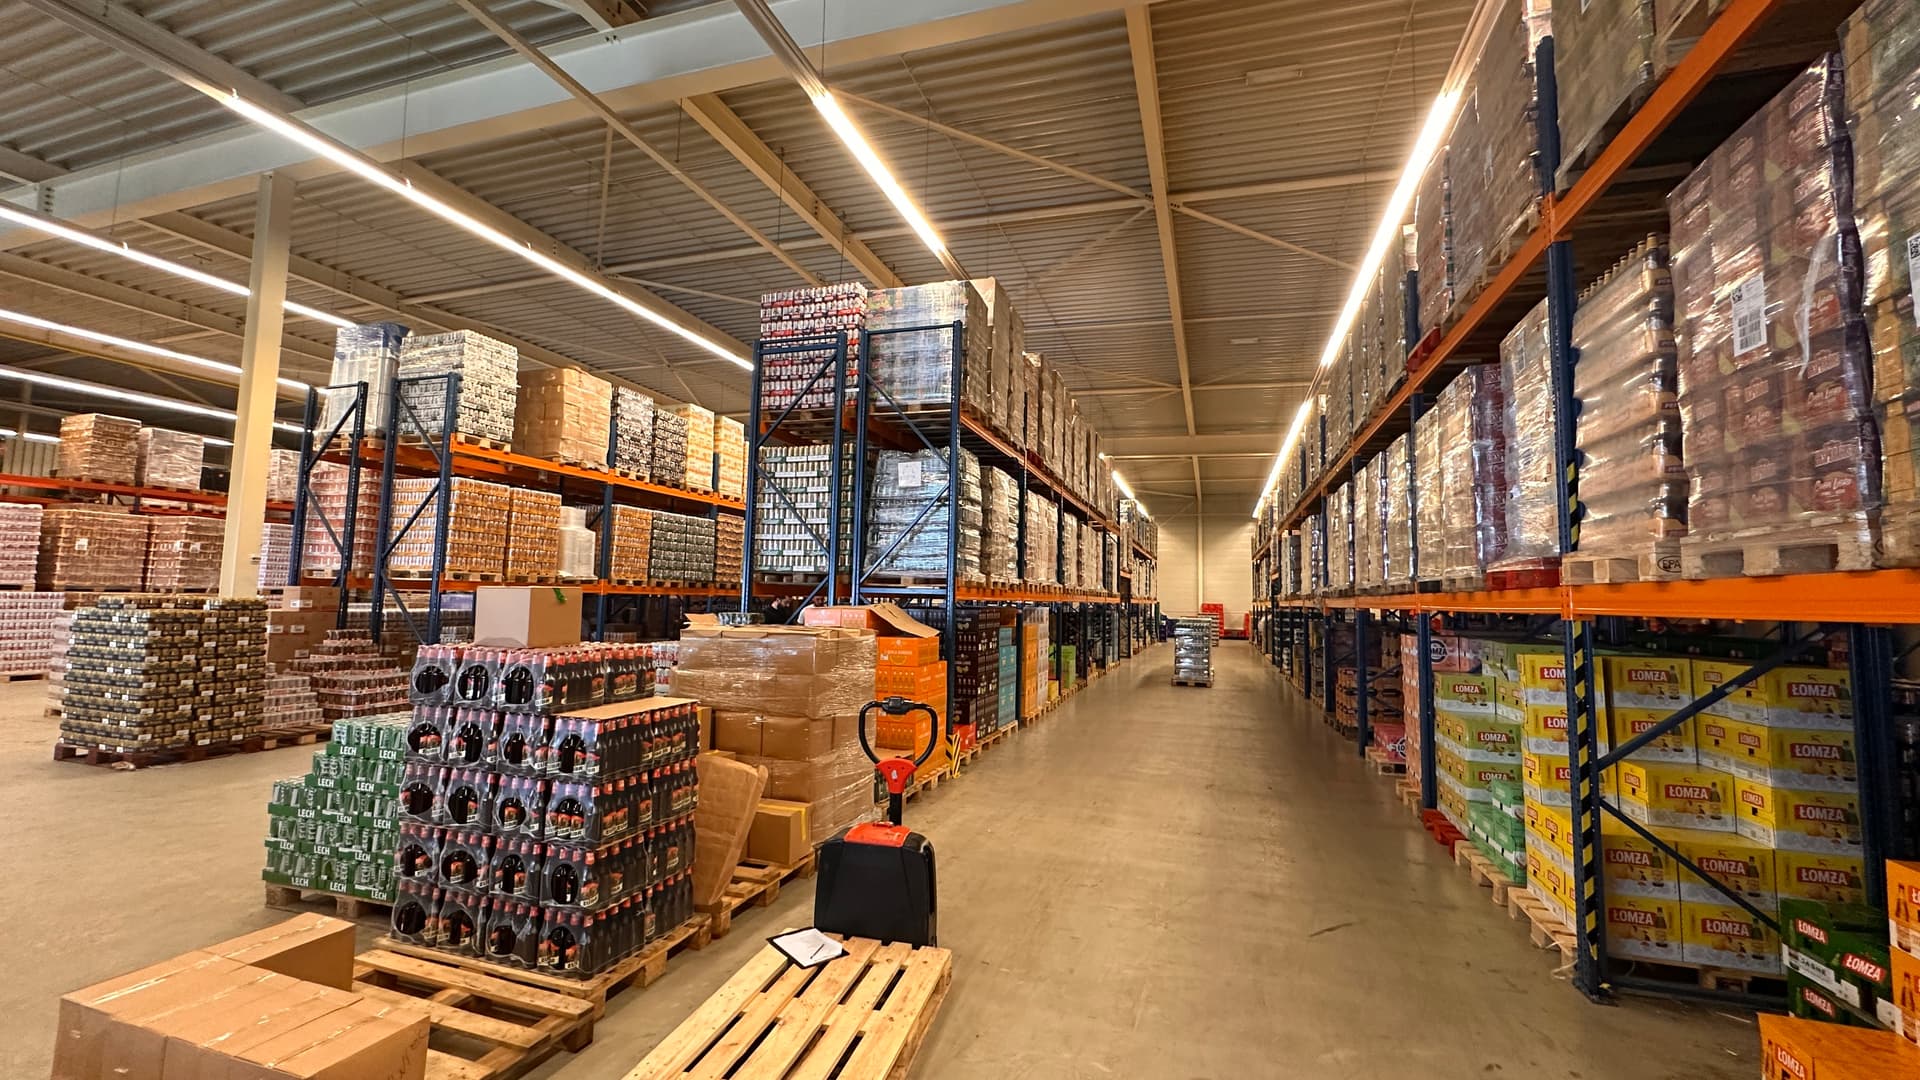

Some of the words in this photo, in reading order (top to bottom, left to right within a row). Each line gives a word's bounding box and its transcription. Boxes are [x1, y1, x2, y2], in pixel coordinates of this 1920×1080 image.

[1543, 668, 1566, 678] ŁOM
[1547, 718, 1568, 728] ŁOM
[340, 746, 357, 756] LECH
[379, 750, 397, 760] LECH
[318, 778, 334, 788] LECH
[357, 783, 374, 792] LECH
[298, 809, 315, 818] LECH
[337, 815, 352, 824] LECH
[374, 819, 391, 829] LECH
[280, 841, 294, 850] LECH
[314, 845, 330, 855] LECH
[355, 852, 371, 862] LECH
[292, 876, 309, 887] LECH
[330, 882, 346, 892] LECH
[371, 889, 387, 900] LECH
